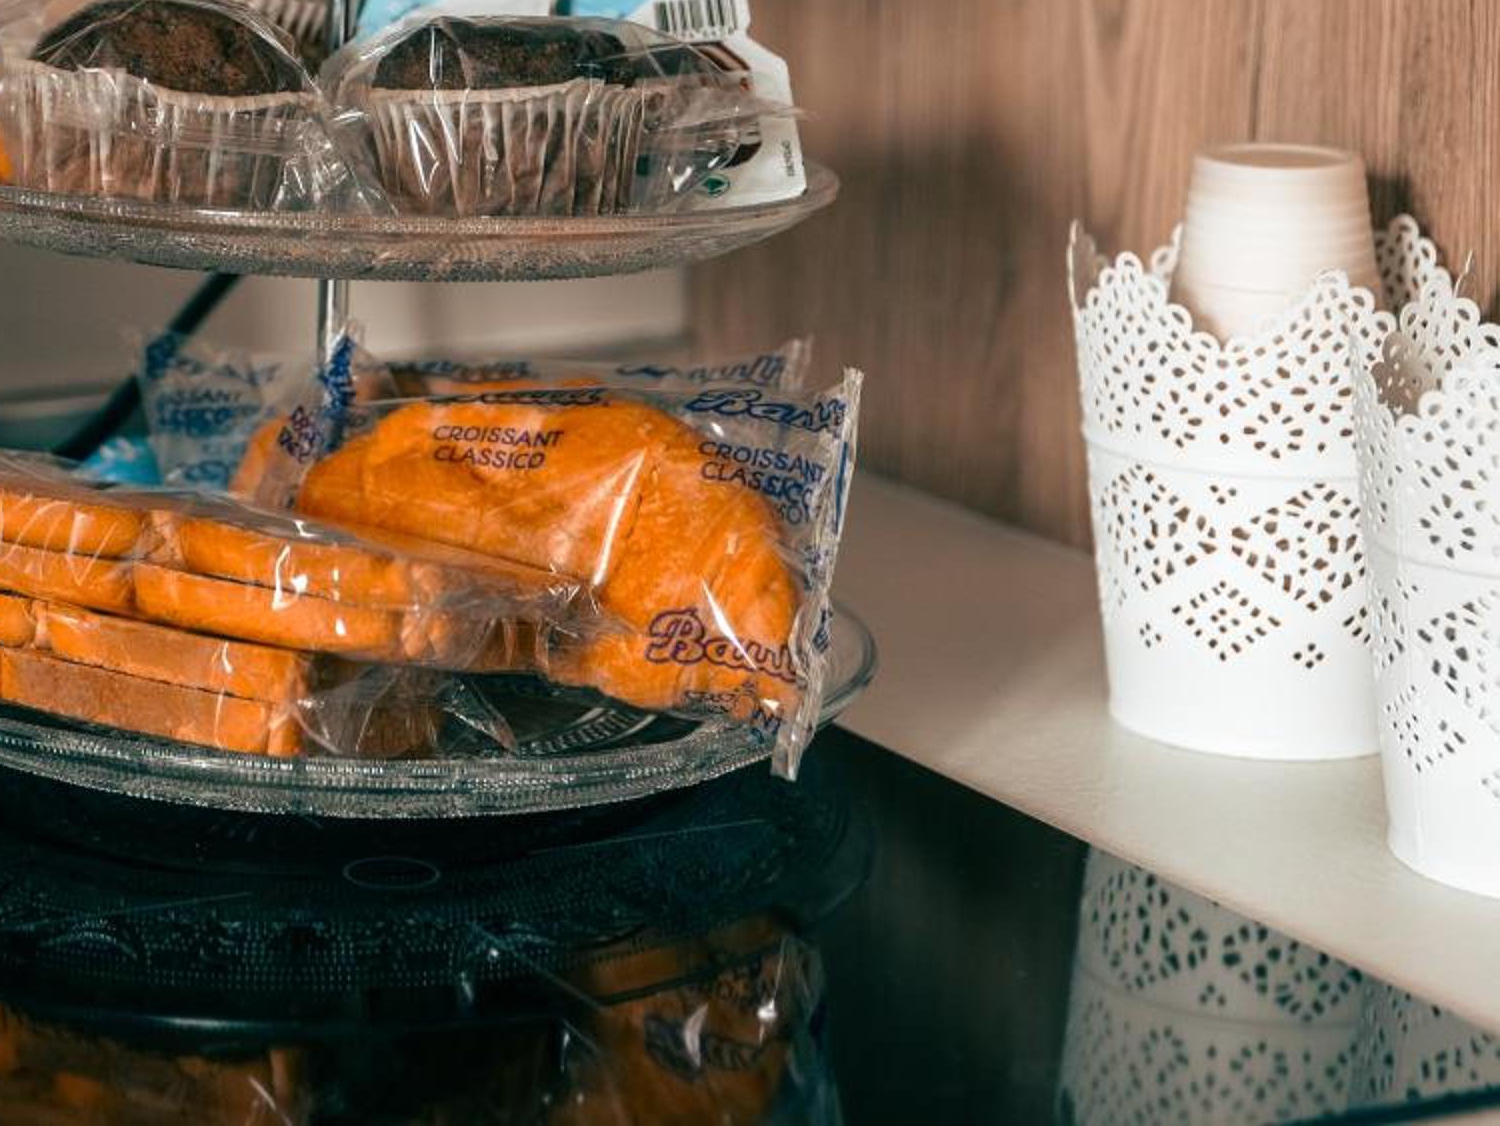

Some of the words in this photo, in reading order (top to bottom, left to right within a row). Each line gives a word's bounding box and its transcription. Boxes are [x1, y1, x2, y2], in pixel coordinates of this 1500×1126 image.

[433, 426, 564, 448] CROISSANT
[433, 445, 546, 470] CLASSICO
[698, 440, 826, 483] CROISSANT
